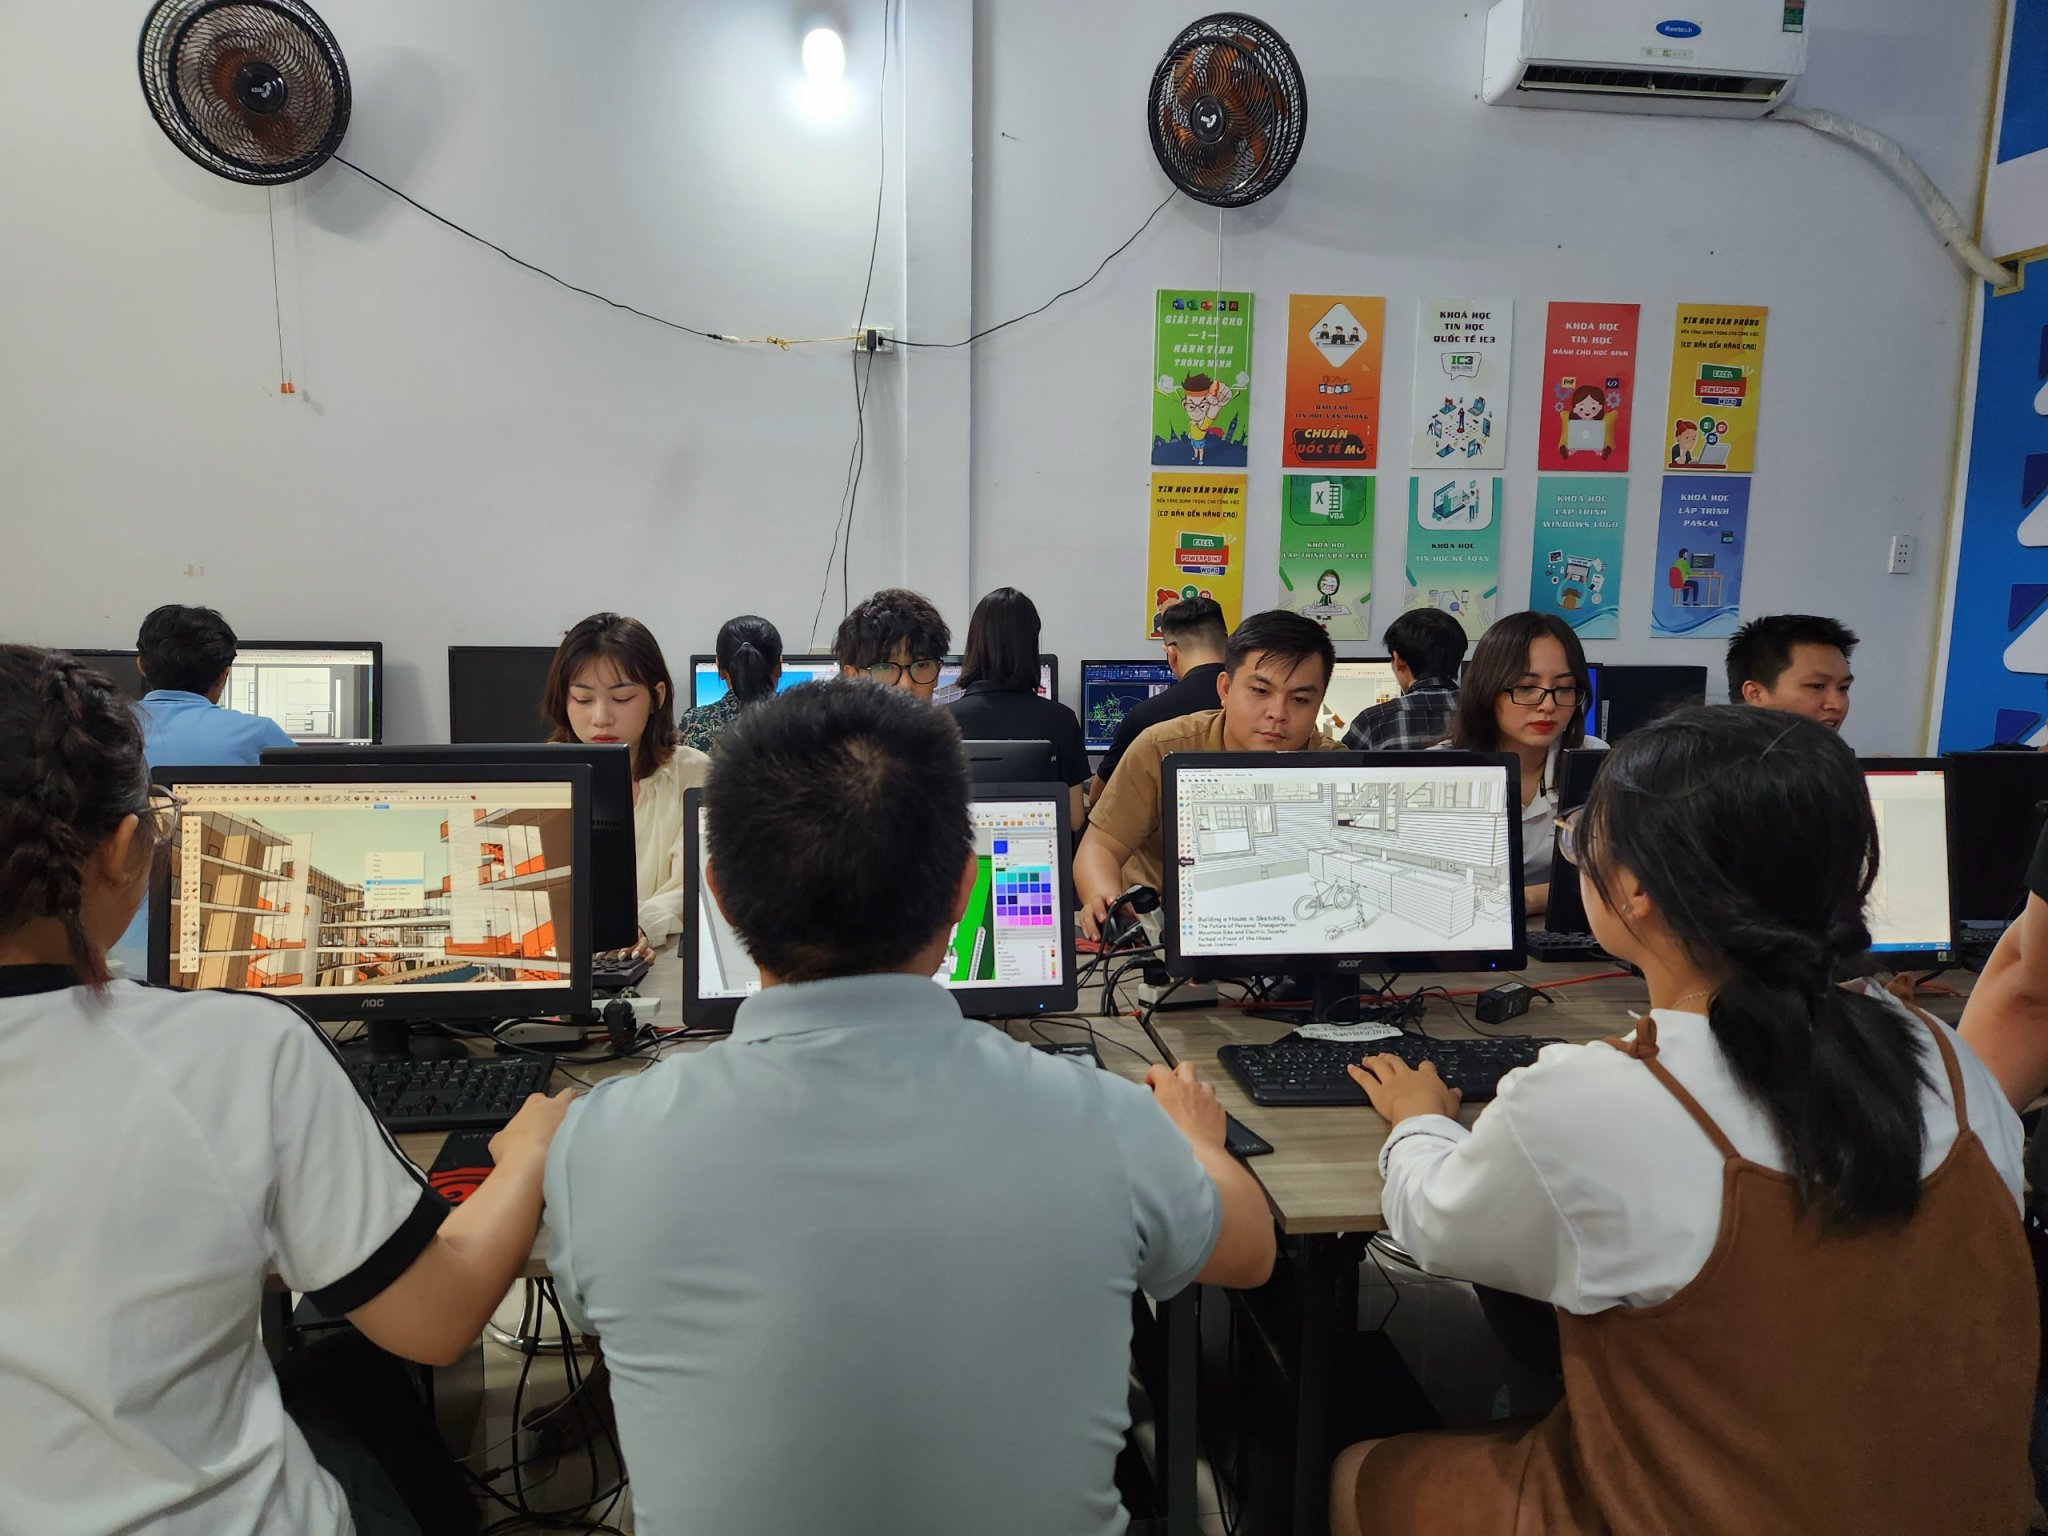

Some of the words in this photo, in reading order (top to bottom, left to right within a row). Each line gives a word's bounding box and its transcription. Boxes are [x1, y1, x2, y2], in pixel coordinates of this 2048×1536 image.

[1664, 25, 1693, 33] Reetech
[1472, 312, 1492, 320] HỌC
[1682, 316, 1698, 324] TIN
[1222, 316, 1242, 326] CHO
[1444, 322, 1461, 330] TIN
[1464, 323, 1485, 332] HỌC
[1480, 336, 1496, 344] IC3
[1571, 336, 1588, 344] TIN
[1451, 355, 1474, 365] IC3
[1712, 370, 1733, 378] EXCEL
[1700, 386, 1740, 394] POWERPOINT
[1329, 512, 1344, 520] VBA
[1543, 520, 1590, 528] WINDOWS
[1683, 520, 1720, 528] PASCAL
[1192, 538, 1214, 547] EXCEL
[1180, 554, 1222, 563] POWERPOINT
[1338, 960, 1362, 968] acer
[361, 998, 384, 1008] AOC
